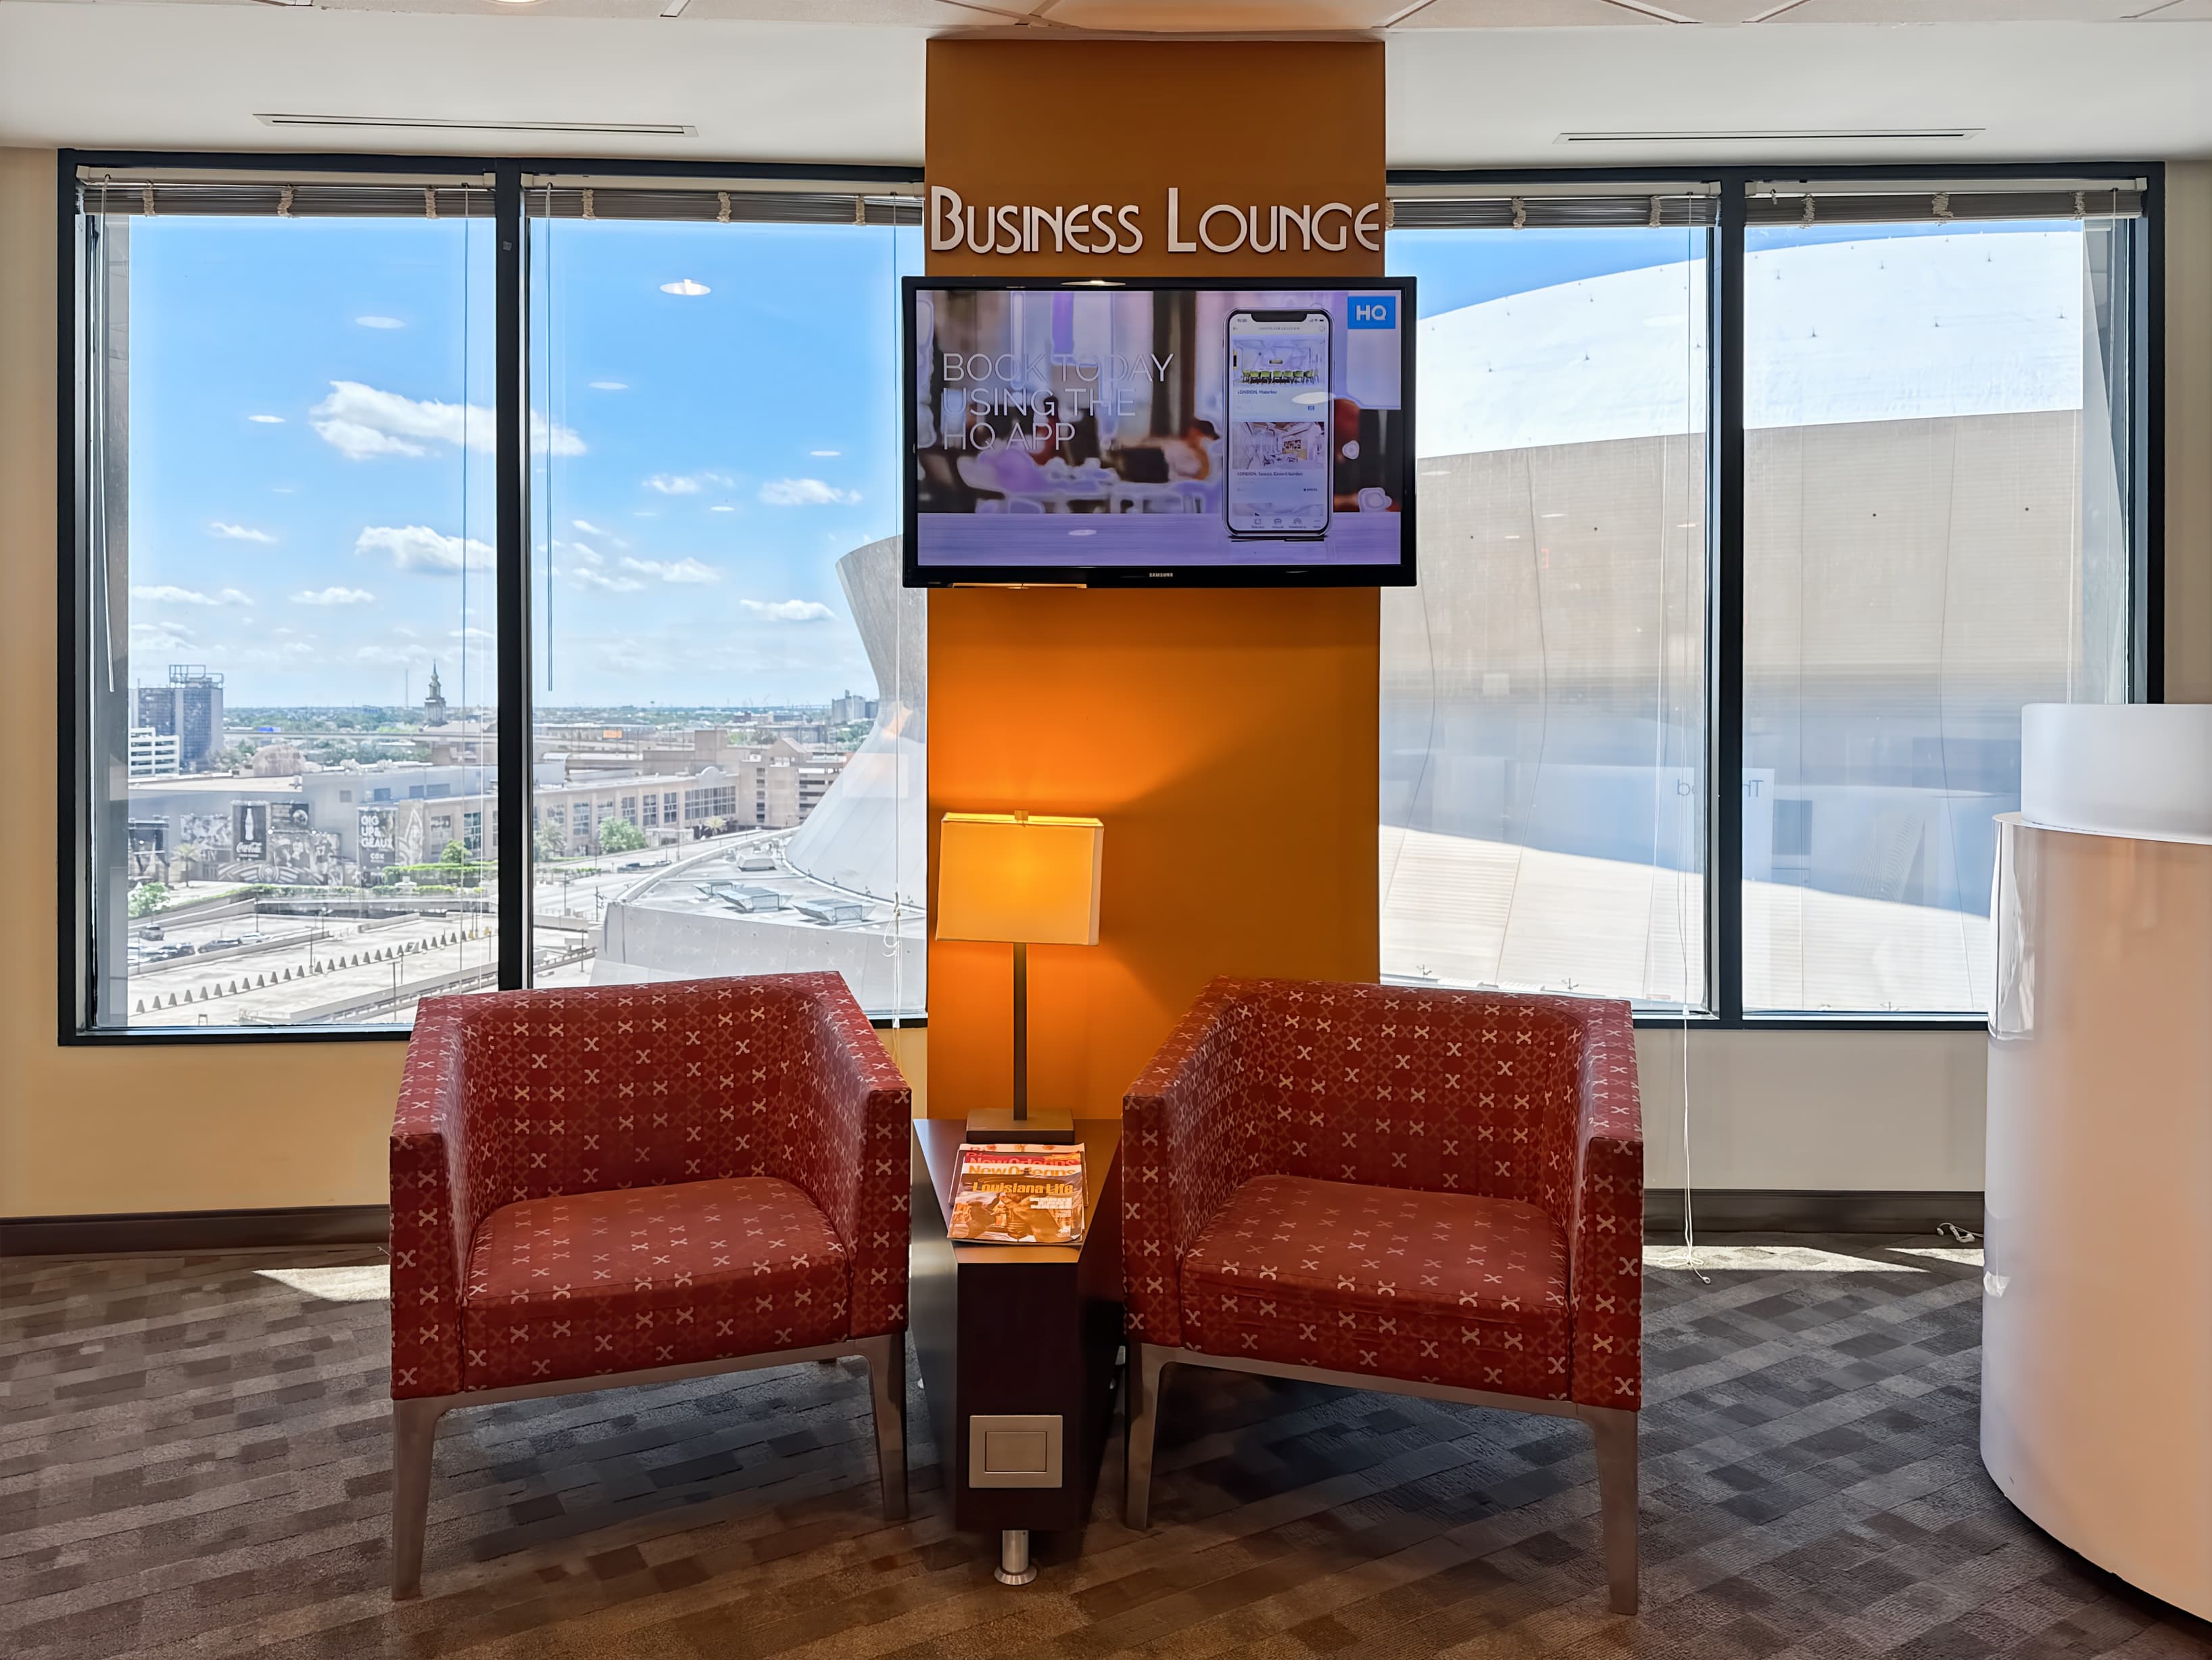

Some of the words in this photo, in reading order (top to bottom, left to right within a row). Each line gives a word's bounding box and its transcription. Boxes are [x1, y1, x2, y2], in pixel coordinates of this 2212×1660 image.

[931, 185, 1143, 254] BUSINESS
[1168, 187, 1380, 254] LOUNGE
[1356, 305, 1387, 321] HQ
[943, 353, 1045, 382] BOOK
[1055, 353, 1174, 382] TODAY
[943, 387, 1055, 417] USING
[1064, 388, 1136, 417] THE
[944, 422, 996, 450] HQ
[1006, 422, 1076, 450] APP
[972, 1182, 1043, 1193] Louisiana
[1046, 1184, 1074, 1194] Life
